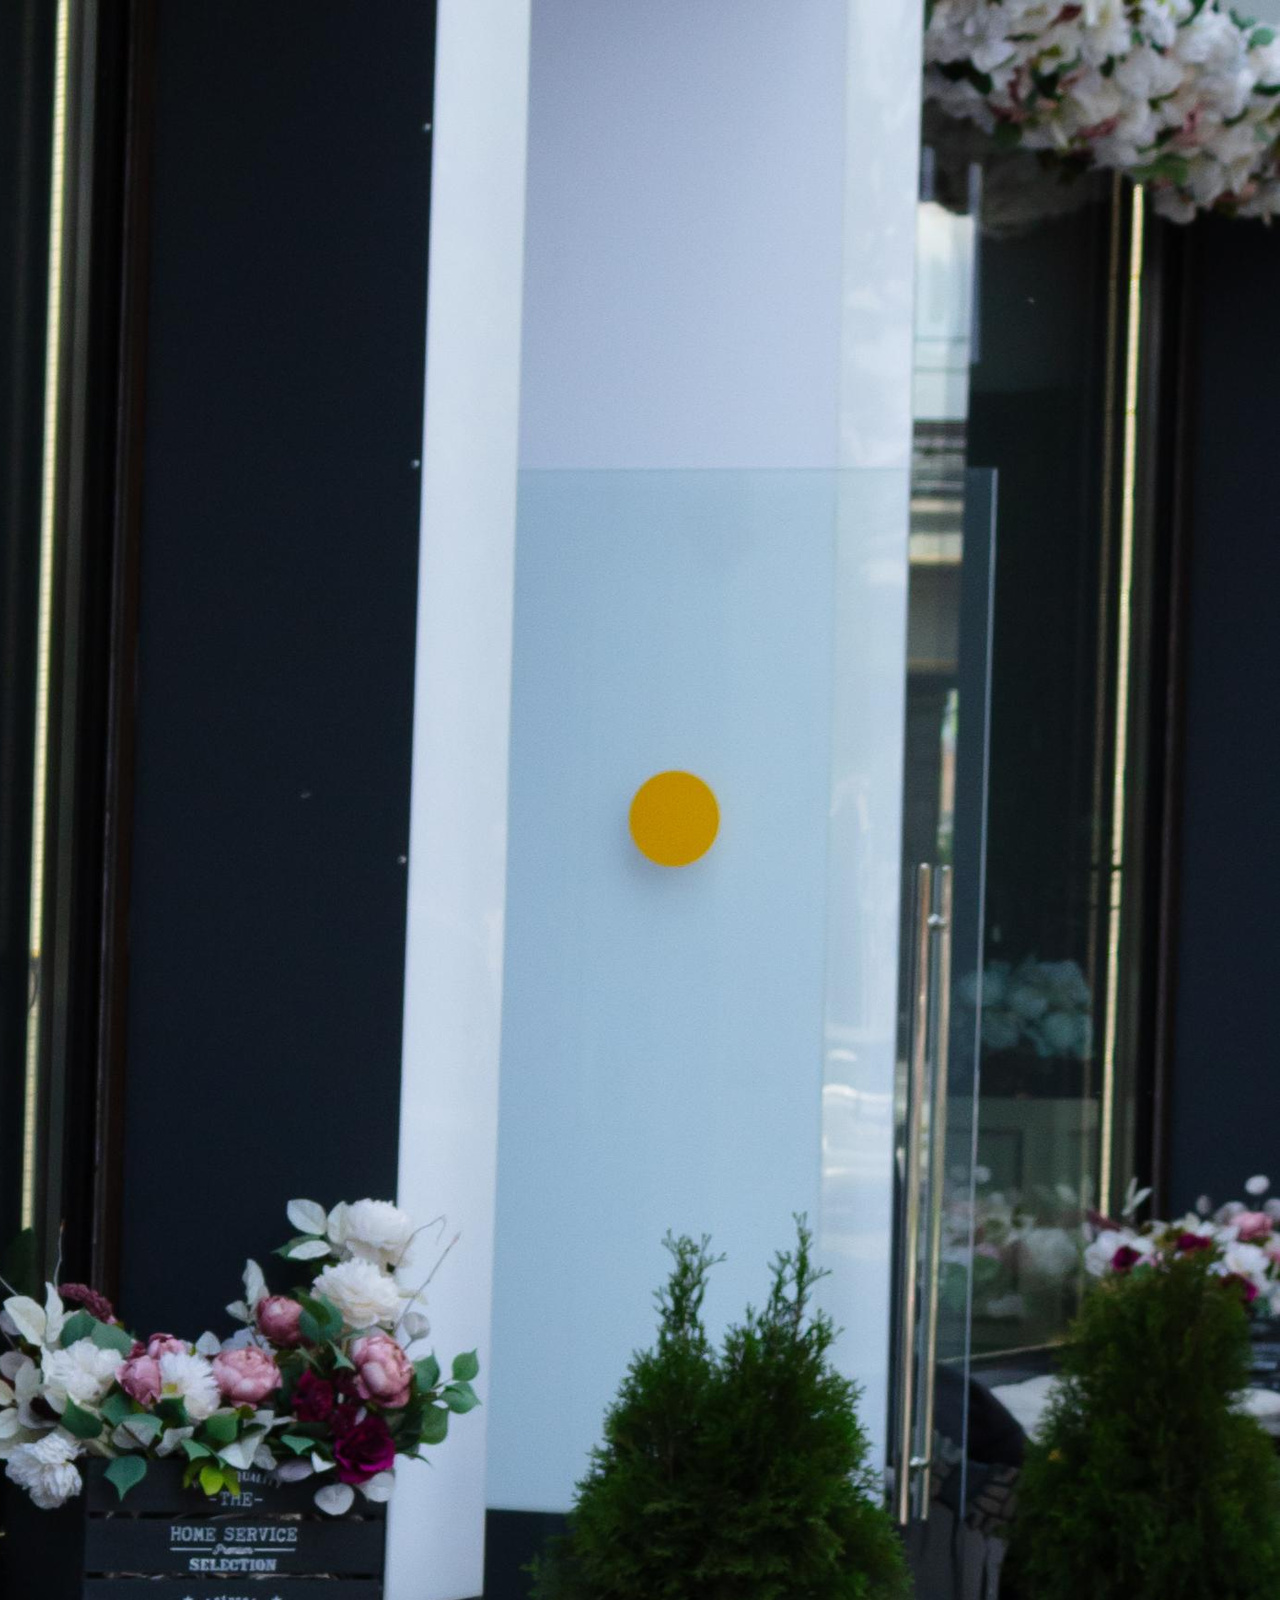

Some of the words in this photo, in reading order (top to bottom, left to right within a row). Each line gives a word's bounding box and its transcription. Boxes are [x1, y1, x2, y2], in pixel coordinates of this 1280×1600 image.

[170, 1526, 216, 1542] HOME
[223, 1526, 298, 1542] SERVICE
[189, 1558, 277, 1571] SELECTION
